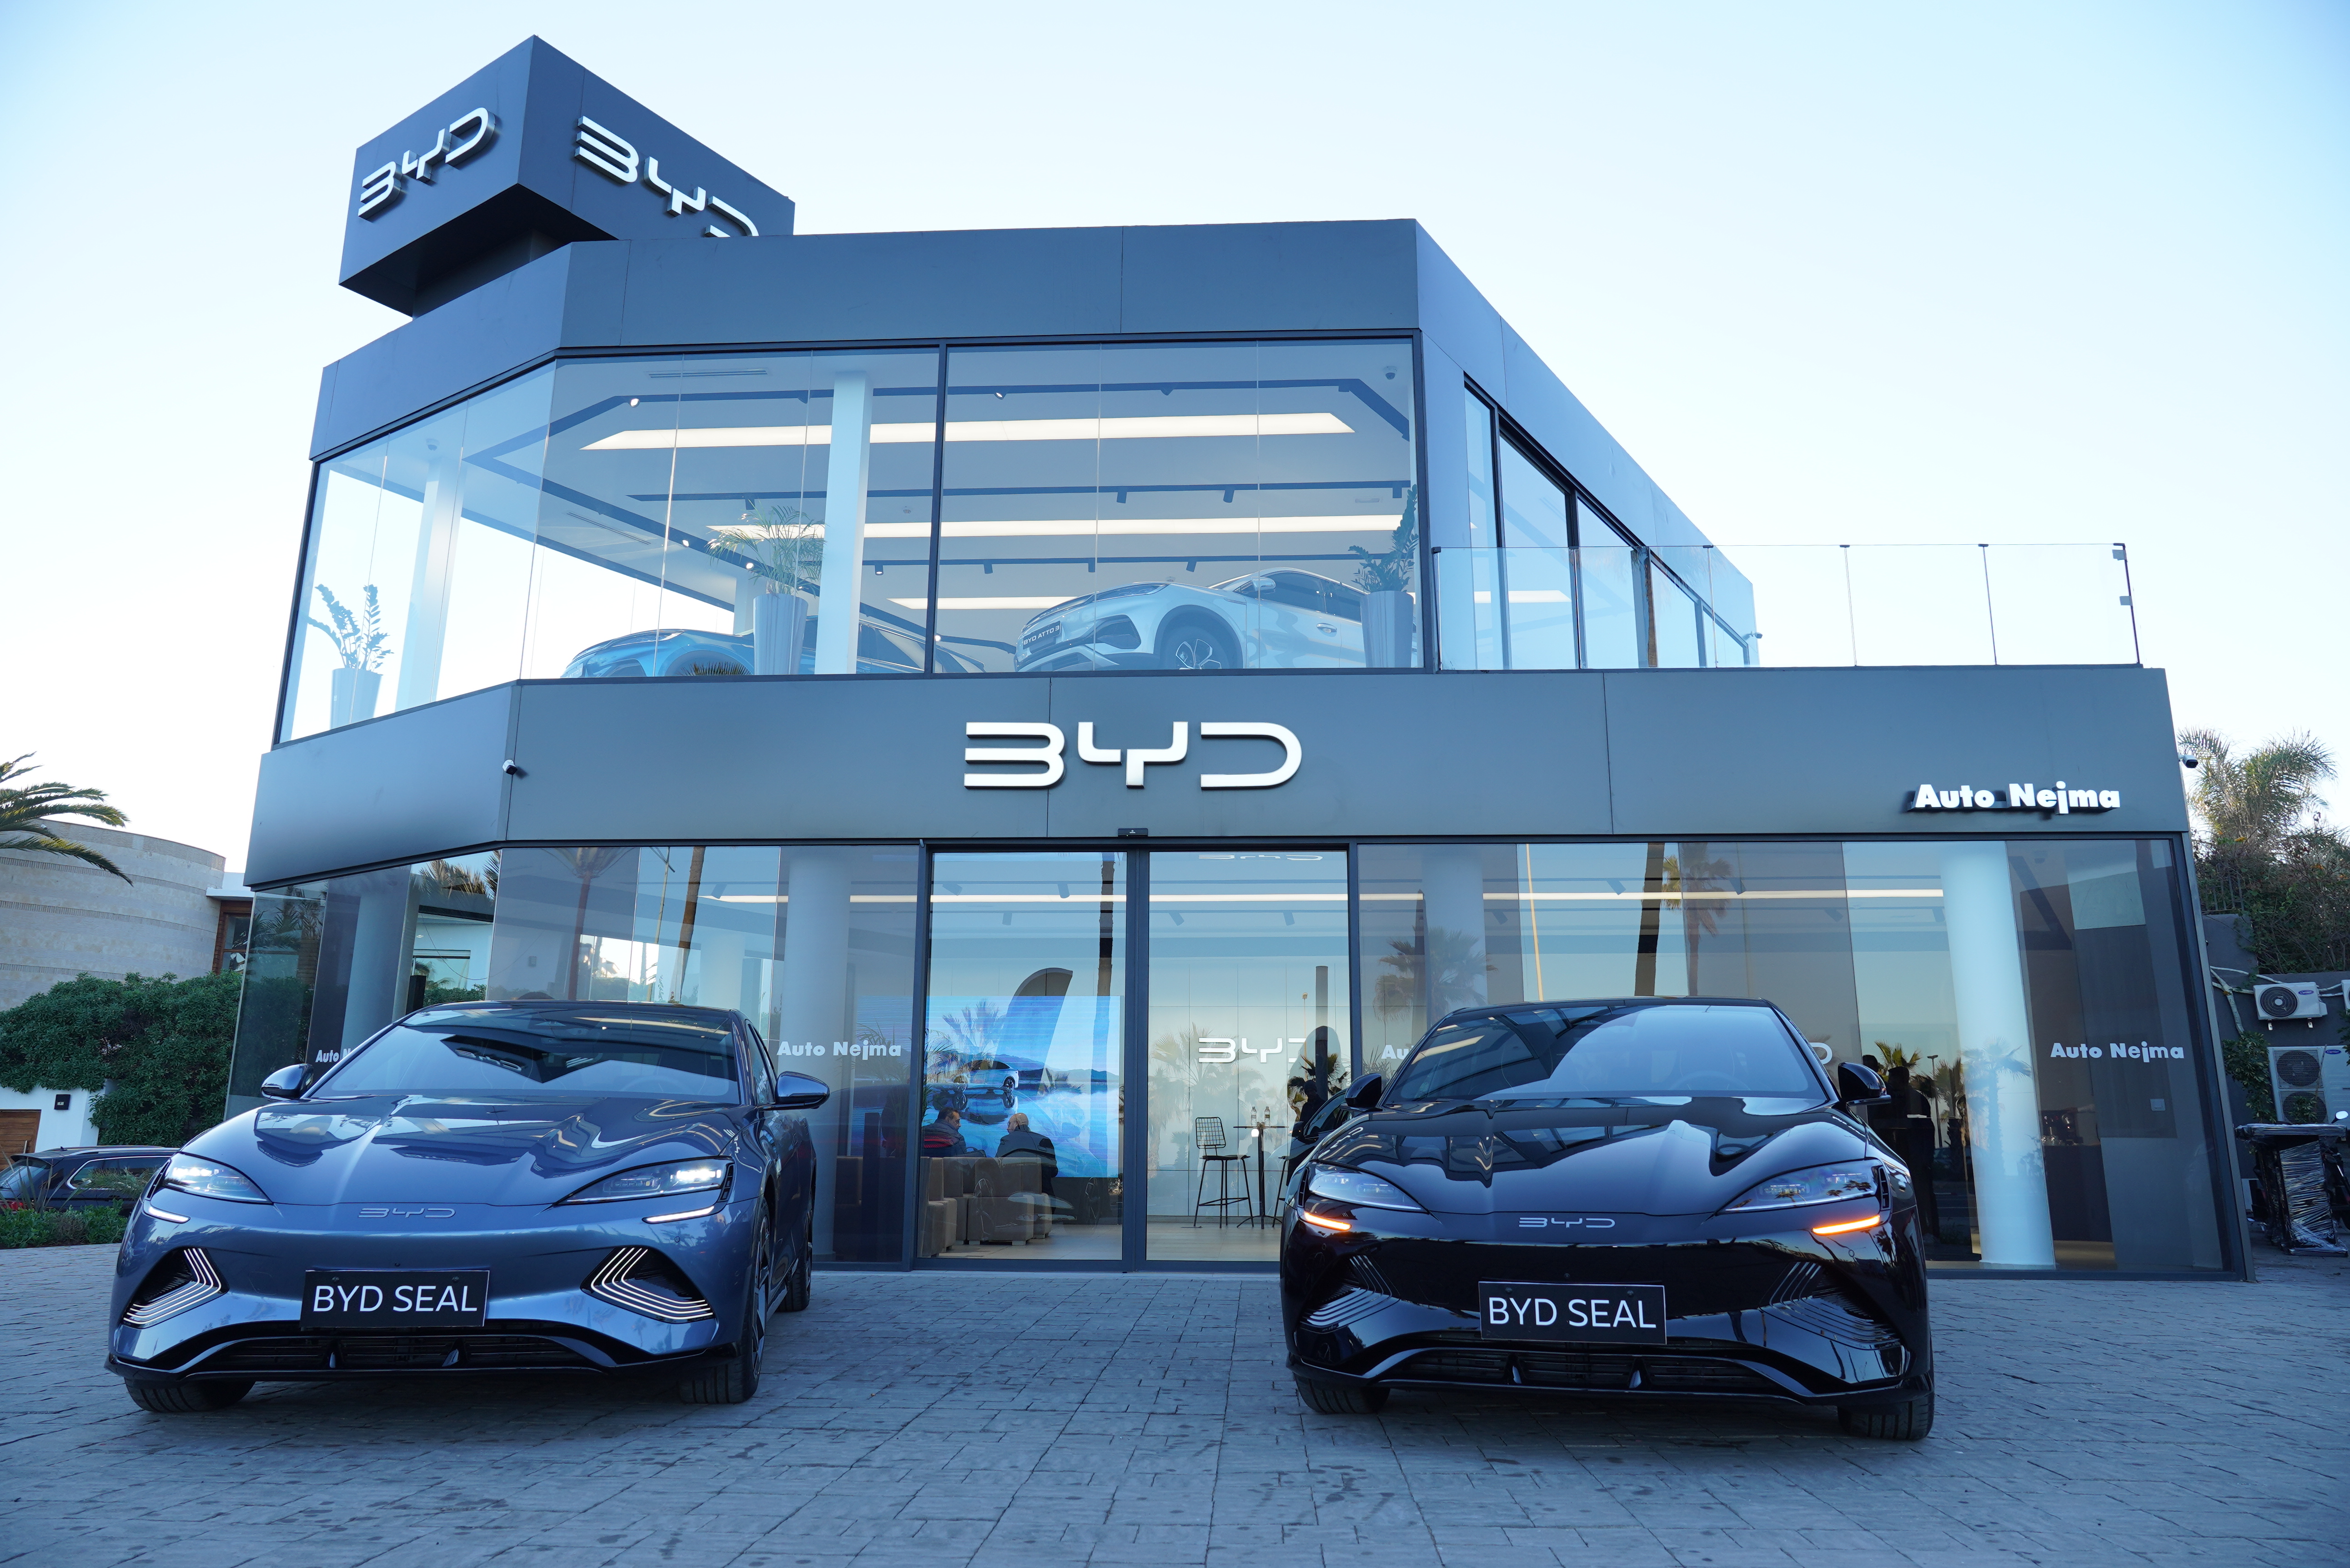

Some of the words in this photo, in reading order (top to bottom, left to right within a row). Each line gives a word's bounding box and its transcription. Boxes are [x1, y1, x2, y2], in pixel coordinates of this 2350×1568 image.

[358, 107, 496, 221] BYD
[1024, 635, 1036, 645] BYD
[1038, 628, 1054, 639] ATTO
[964, 721, 1302, 789] BYD
[1913, 784, 1995, 809] Auto
[2009, 781, 2120, 814] Nejma
[315, 1050, 340, 1063] Auto
[777, 1041, 825, 1056] Auto
[834, 1040, 901, 1060] Nejma
[2050, 1042, 2102, 1058] Auto
[2110, 1041, 2184, 1063] Nejma
[358, 1207, 456, 1218] BYD
[1519, 1217, 1616, 1228] BYD
[313, 1285, 383, 1312] BYD
[393, 1285, 477, 1312] SEAL
[1489, 1297, 1557, 1326] BYD
[1568, 1299, 1657, 1328] SEAL
